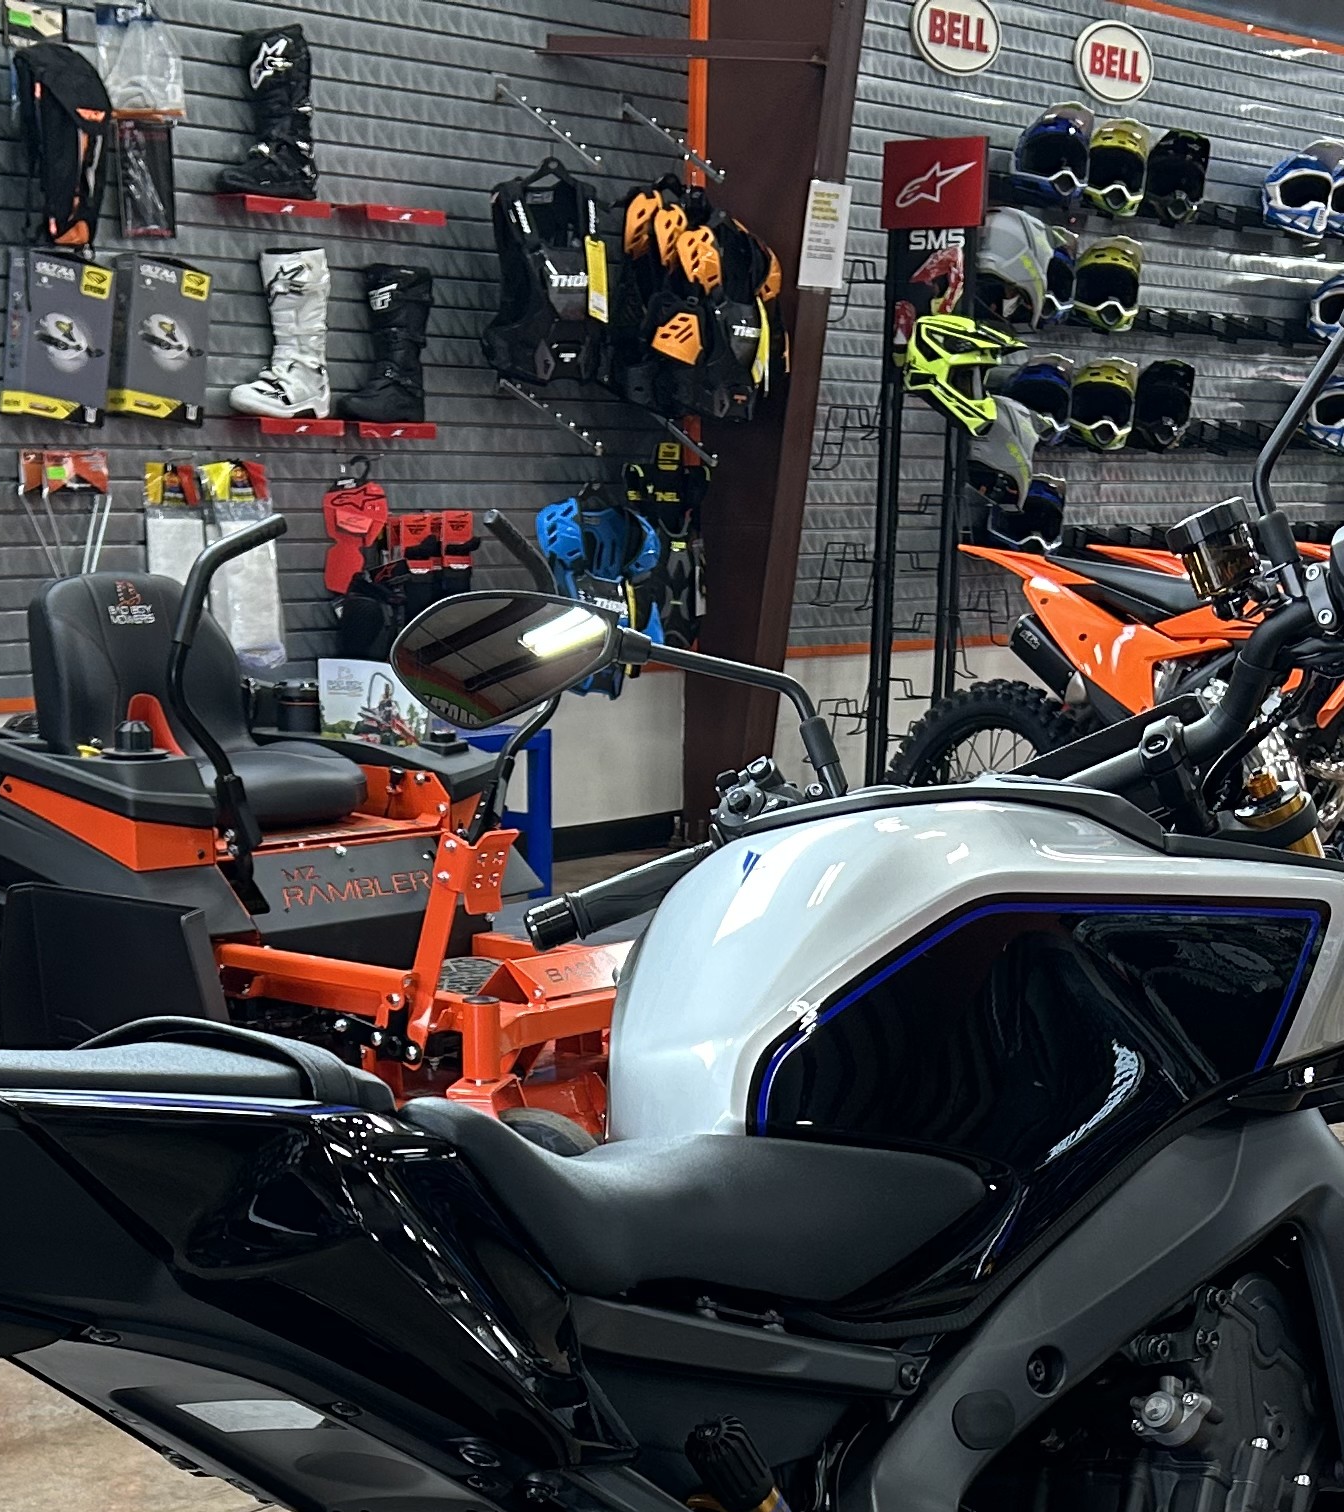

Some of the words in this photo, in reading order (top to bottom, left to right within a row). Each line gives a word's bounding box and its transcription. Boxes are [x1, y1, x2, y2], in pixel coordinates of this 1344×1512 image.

[928, 7, 990, 54] BELL
[1089, 41, 1143, 84] BELL
[549, 274, 588, 287] THO
[281, 864, 321, 883] MZ
[281, 869, 433, 909] RAMBLER
